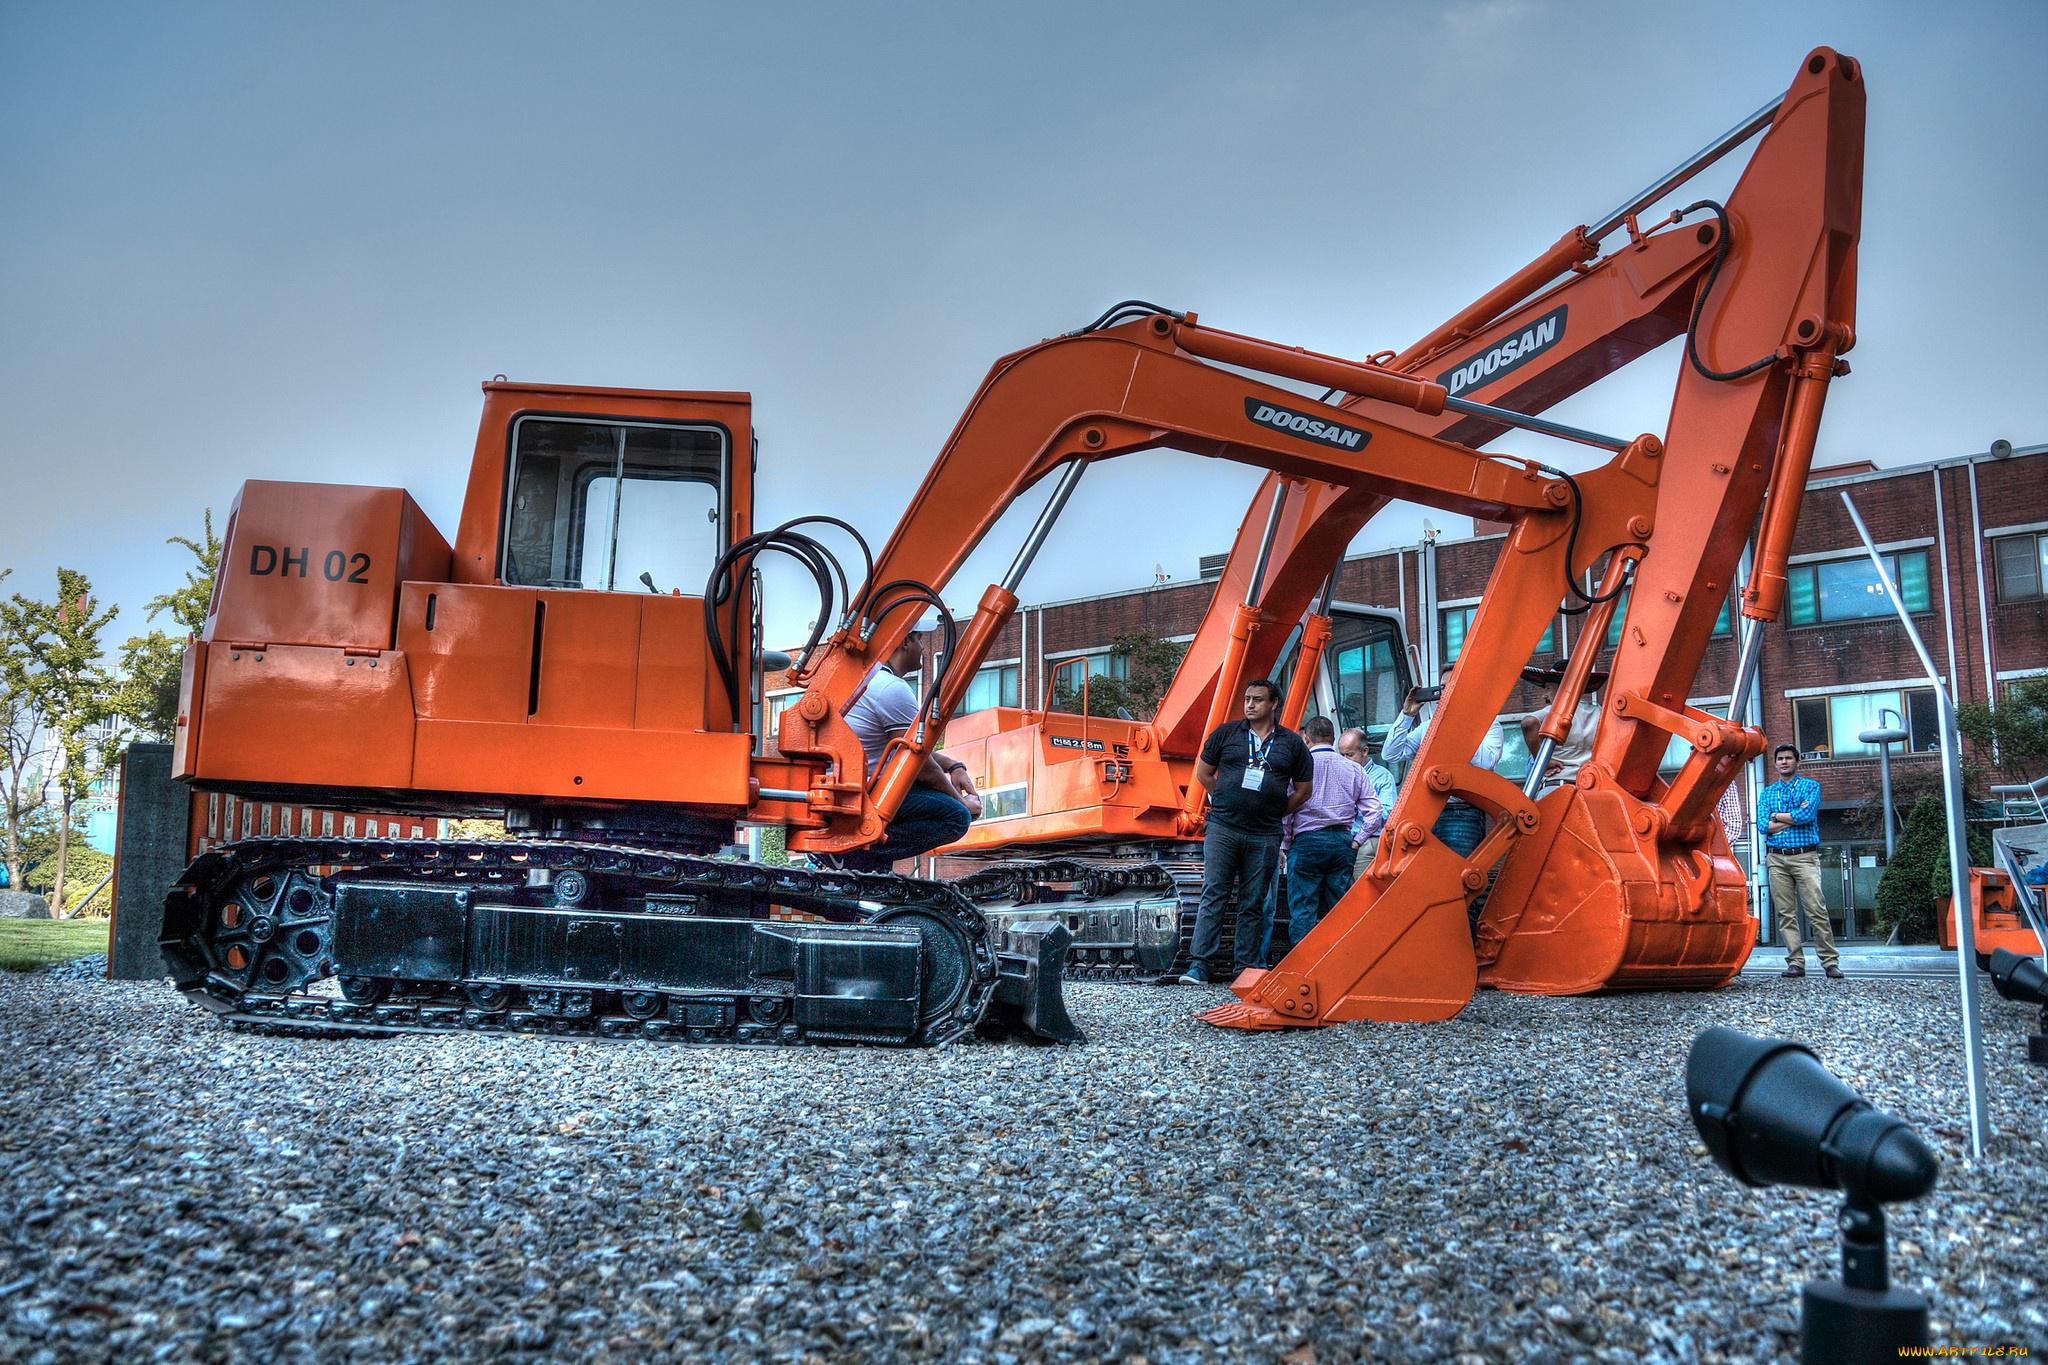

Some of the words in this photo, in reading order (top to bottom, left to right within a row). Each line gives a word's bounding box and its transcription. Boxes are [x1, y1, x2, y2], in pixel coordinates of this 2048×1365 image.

[1449, 316, 1556, 395] DOOSAN
[1253, 405, 1361, 447] DOOSAN
[249, 545, 309, 578] DH
[324, 550, 371, 584] 02
